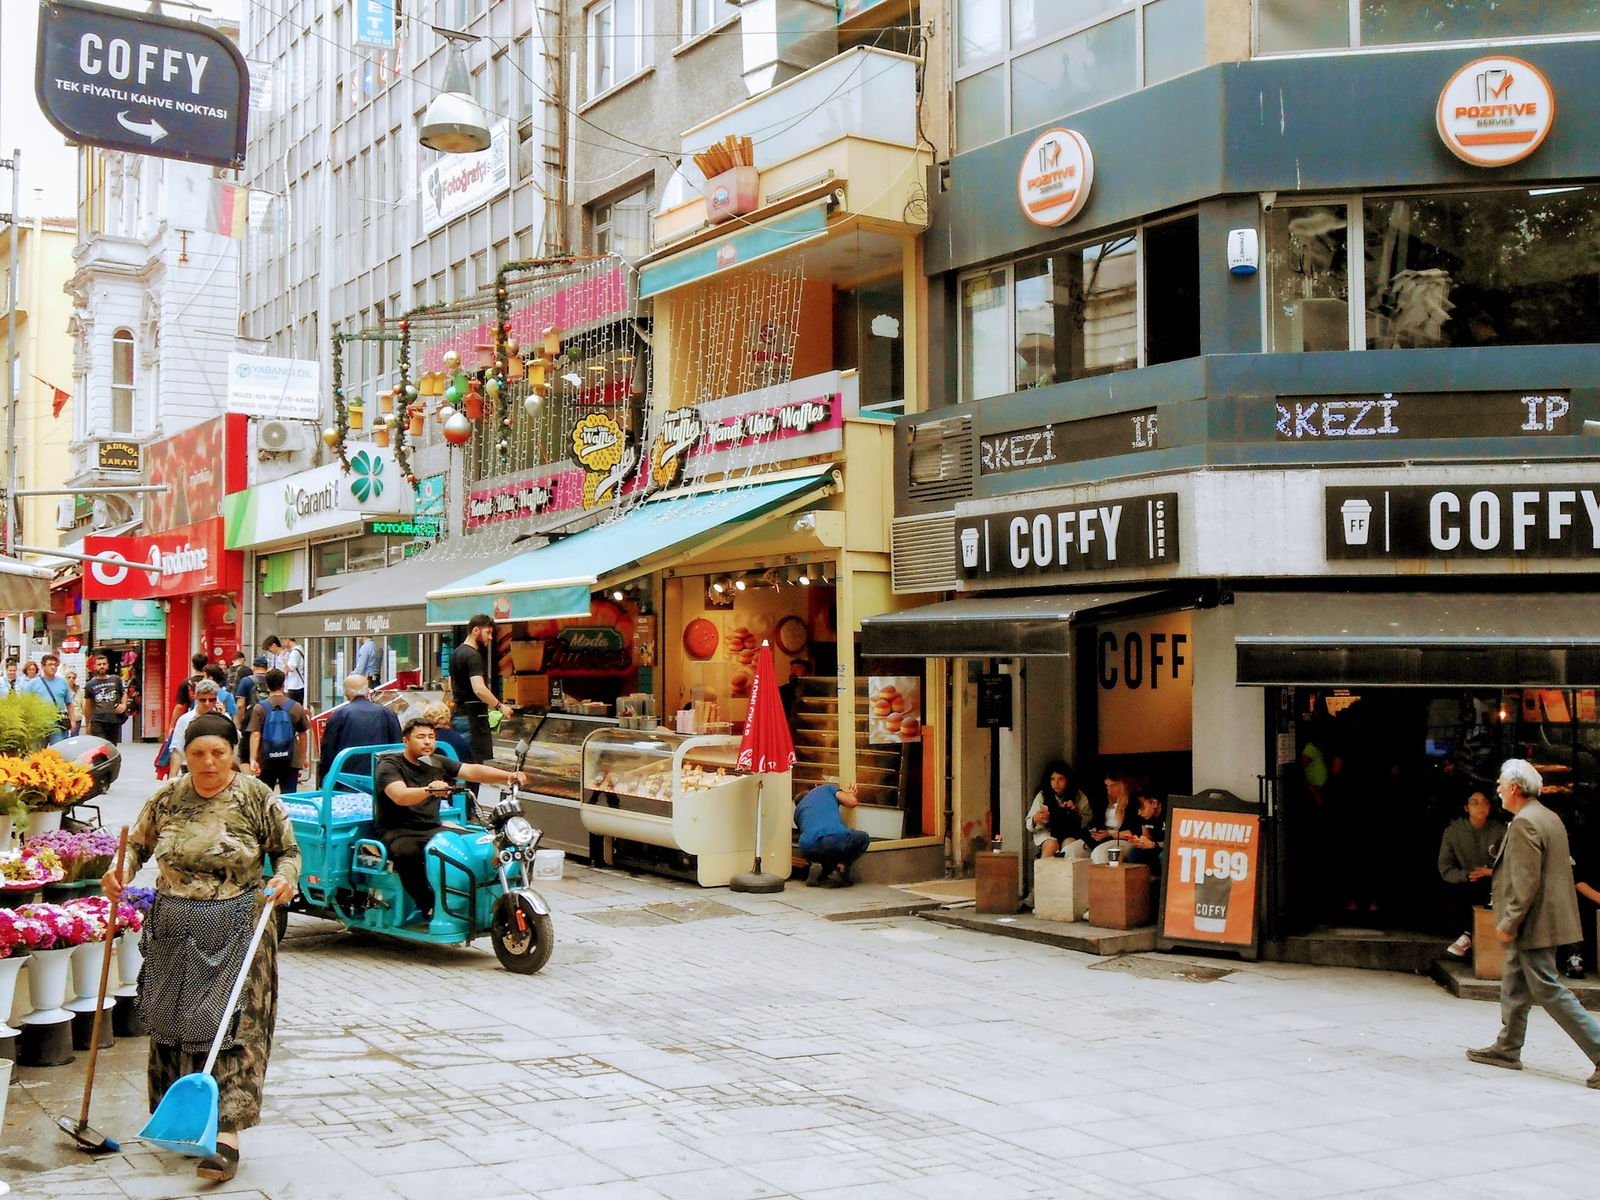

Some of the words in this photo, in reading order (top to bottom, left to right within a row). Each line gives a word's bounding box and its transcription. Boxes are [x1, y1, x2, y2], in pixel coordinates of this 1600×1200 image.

[79, 32, 209, 95] COFFY
[55, 78, 80, 93] TEK
[82, 83, 128, 101] FİYATLI
[130, 93, 173, 110] KAHVE
[175, 101, 228, 120] NOKTASI
[779, 402, 825, 431] Waffles
[100, 457, 138, 466] SARAYI
[296, 481, 332, 516] Garanti
[1010, 505, 1123, 569] COFFY
[569, 630, 609, 648] Moda
[1099, 631, 1192, 690] COFF
[1179, 818, 1253, 844] UYANIN!
[1177, 847, 1249, 885] 11.99
[1196, 903, 1227, 918] COFFY
